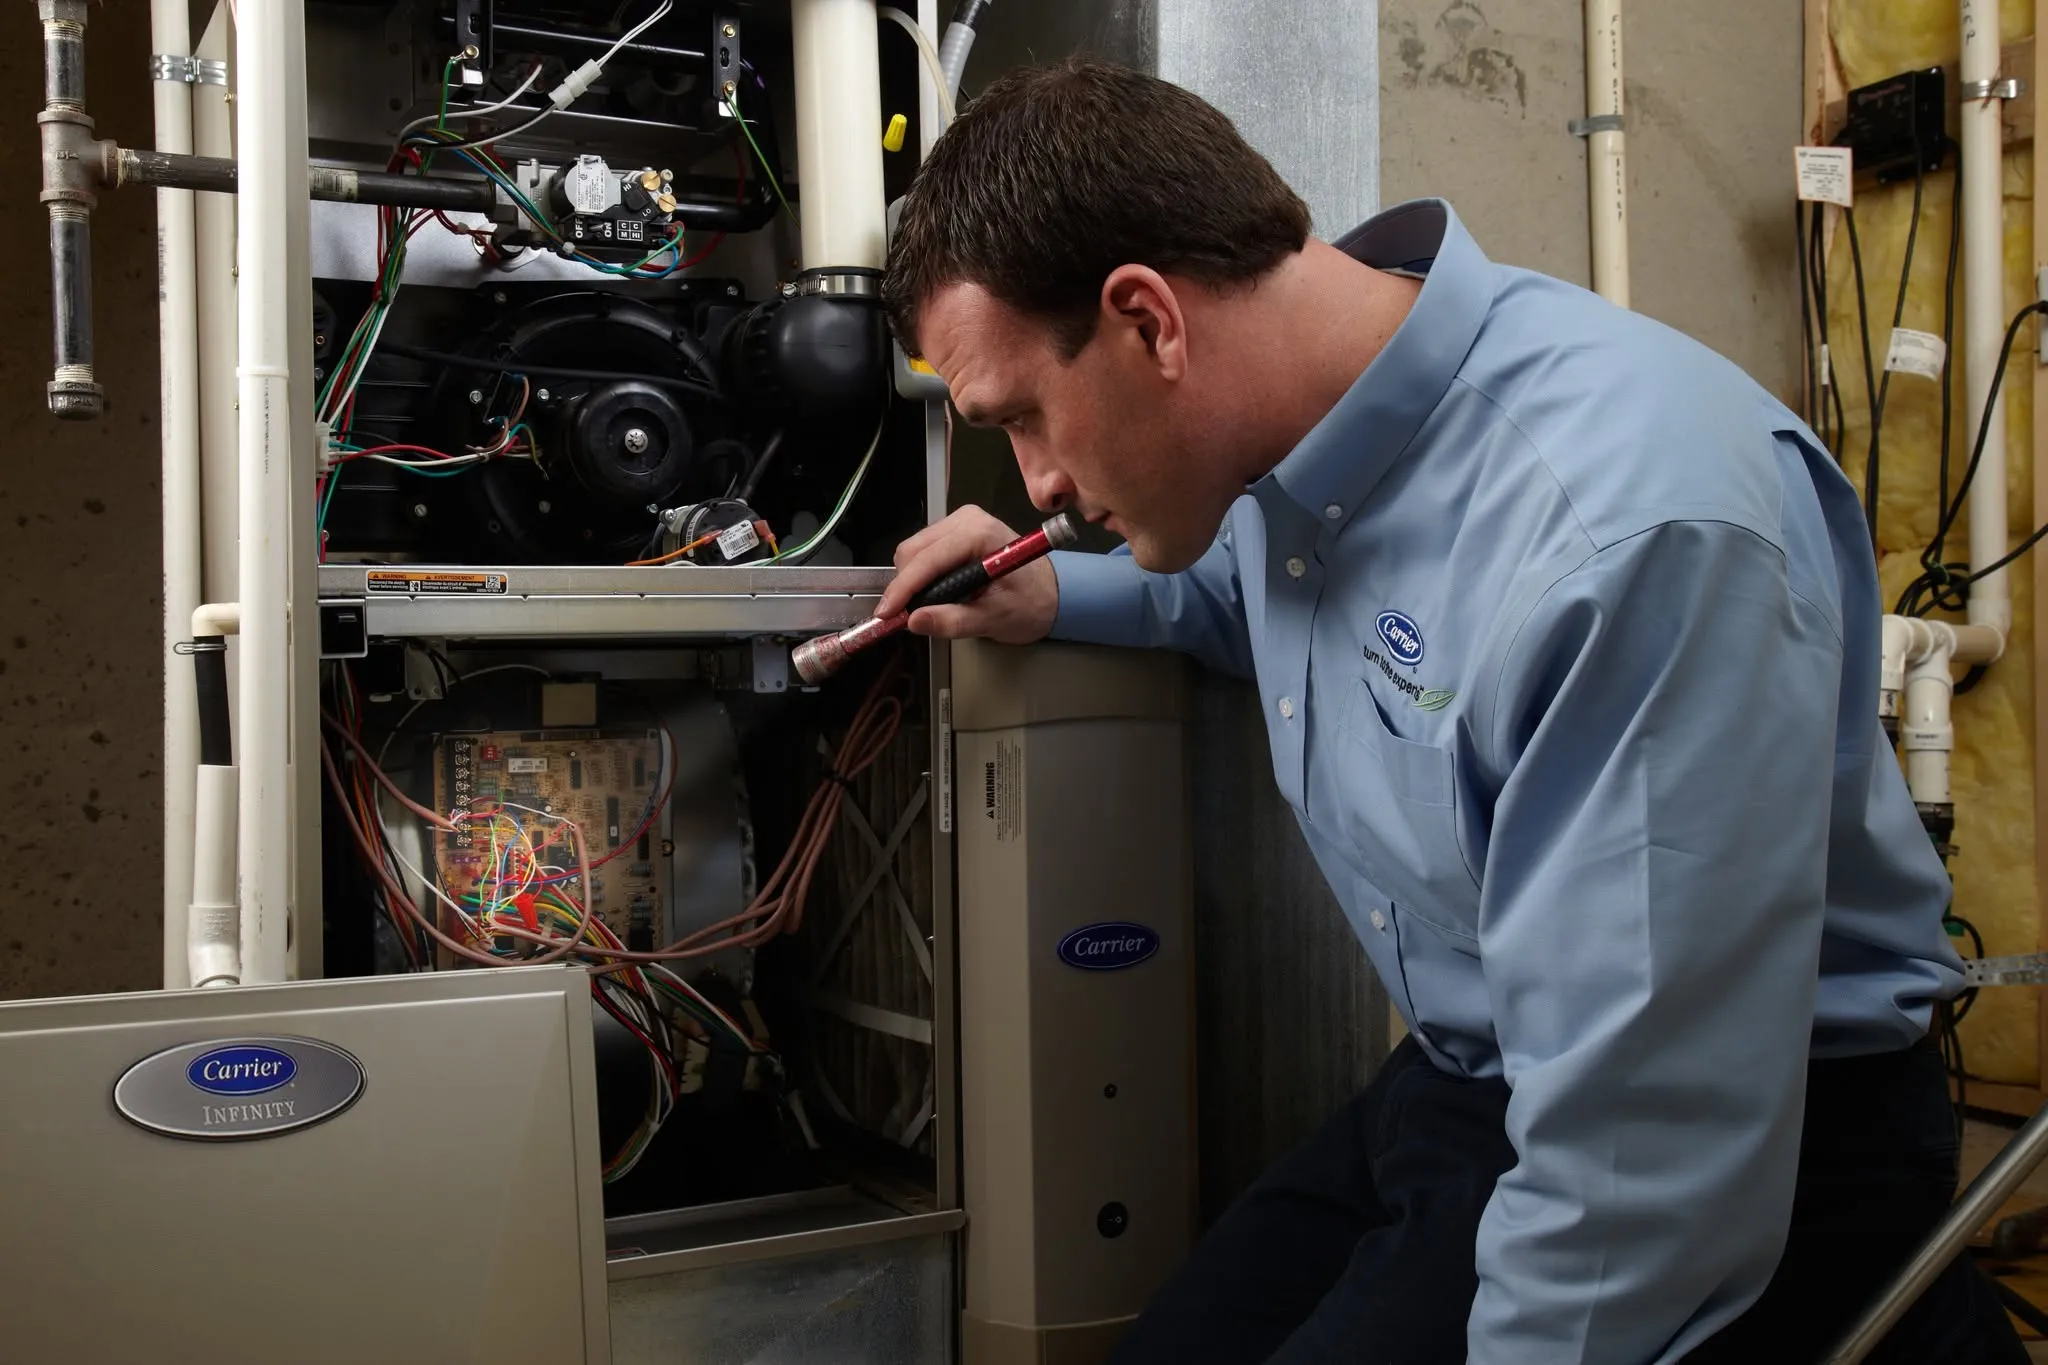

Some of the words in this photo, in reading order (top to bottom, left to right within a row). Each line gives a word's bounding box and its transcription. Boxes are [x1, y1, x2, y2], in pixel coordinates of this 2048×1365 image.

[622, 183, 632, 191] HI
[642, 208, 651, 217] LO
[575, 217, 583, 238] OFF
[604, 222, 612, 238] ON
[1384, 617, 1419, 654] Carrier
[1363, 645, 1379, 664] turn
[986, 762, 995, 808] WARNING
[1074, 934, 1146, 956] Carrier
[203, 1058, 282, 1081] Carrier
[202, 1100, 296, 1126] INFINITY
